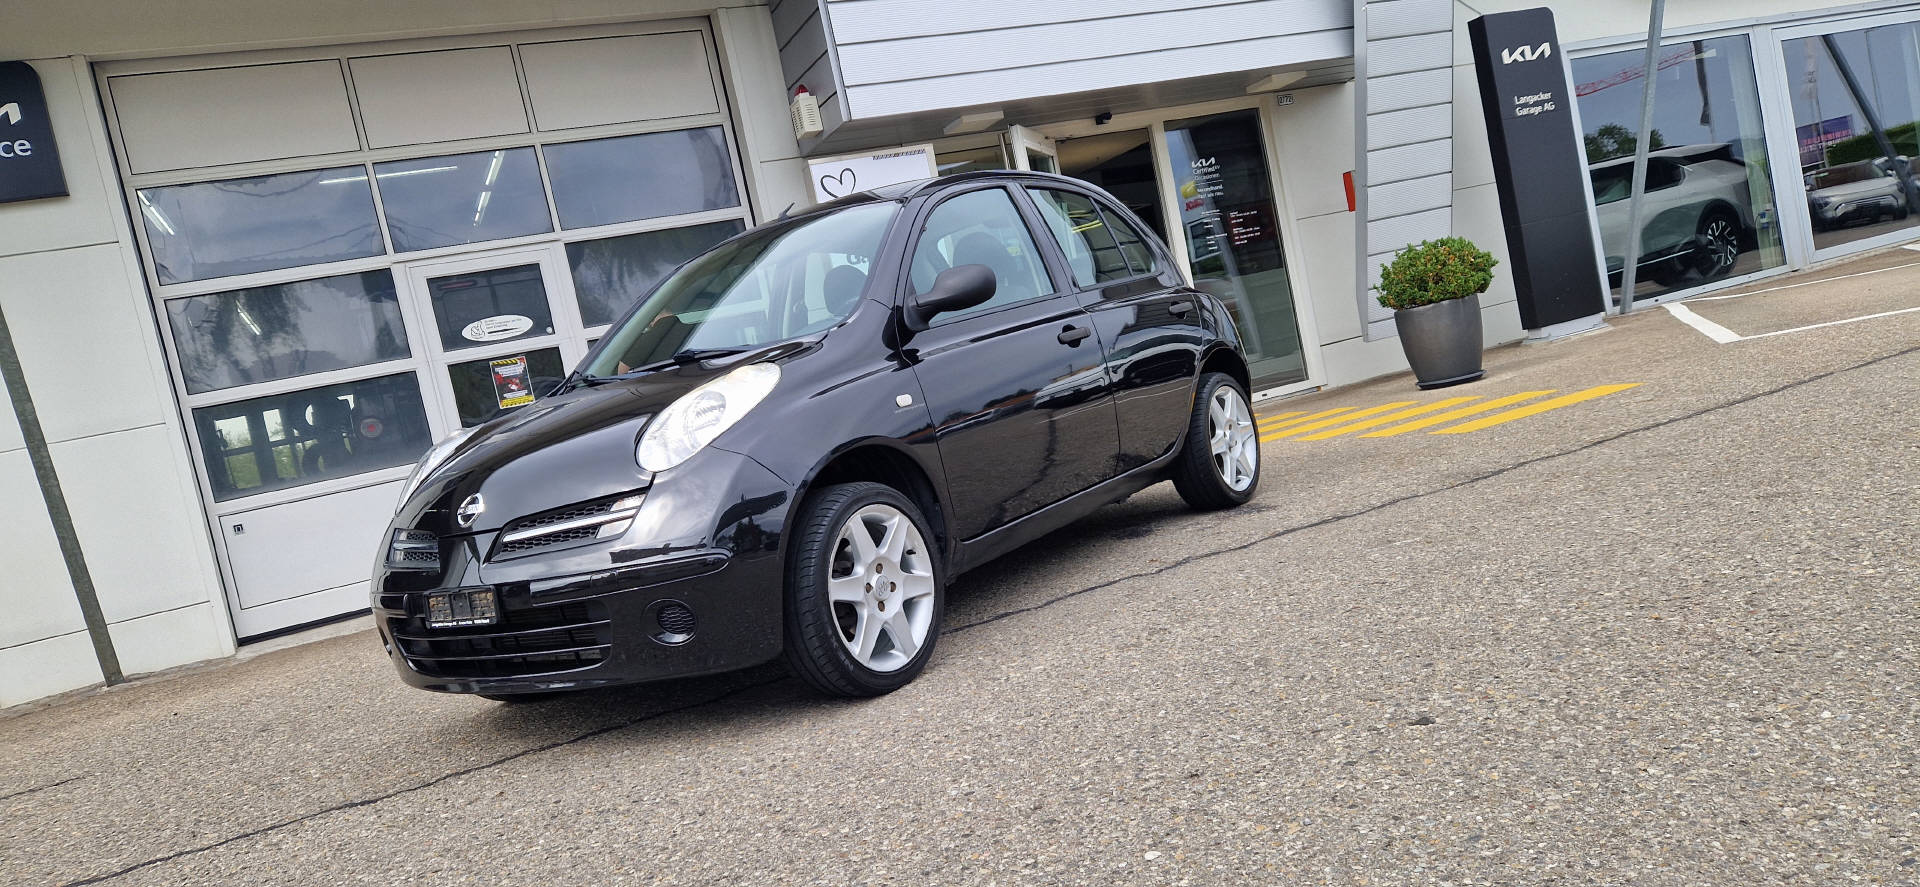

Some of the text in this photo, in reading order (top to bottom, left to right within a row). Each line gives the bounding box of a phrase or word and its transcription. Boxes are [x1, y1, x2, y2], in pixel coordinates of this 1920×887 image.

[1501, 42, 1551, 65] KIA
[1514, 92, 1552, 104] Langacker
[1516, 101, 1556, 116] Garage AG
[1192, 157, 1215, 168] KIA
